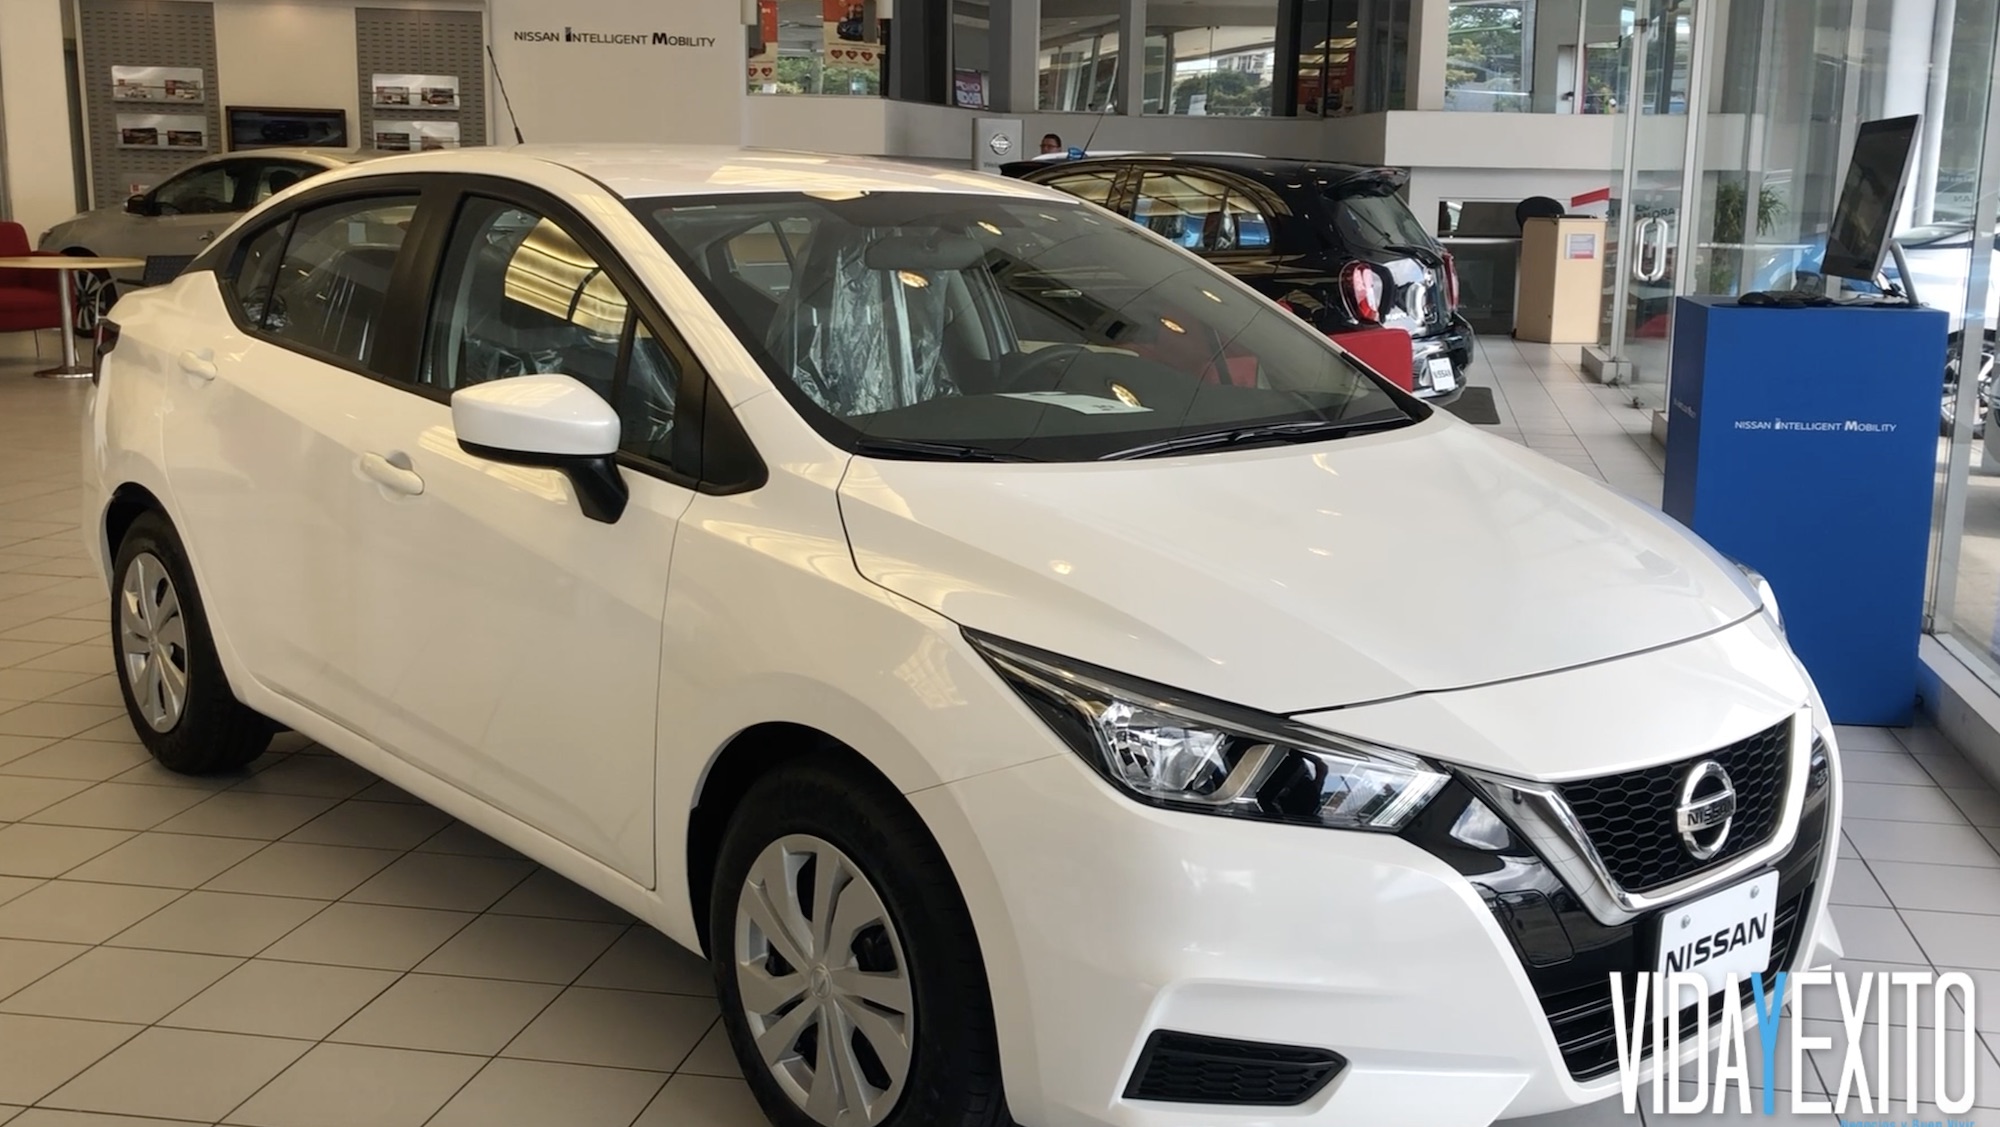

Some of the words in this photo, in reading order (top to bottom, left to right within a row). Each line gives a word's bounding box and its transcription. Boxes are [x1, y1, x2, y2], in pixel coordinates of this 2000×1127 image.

[513, 31, 560, 42] NISSAN
[565, 27, 648, 45] INTELLIGENT
[652, 32, 716, 48] MOBILITY
[1734, 420, 1772, 430] NISSAN
[1774, 418, 1842, 431] INTELLIGENT
[1844, 420, 1897, 433] MOBILITY
[1665, 912, 1768, 979] NISSAN
